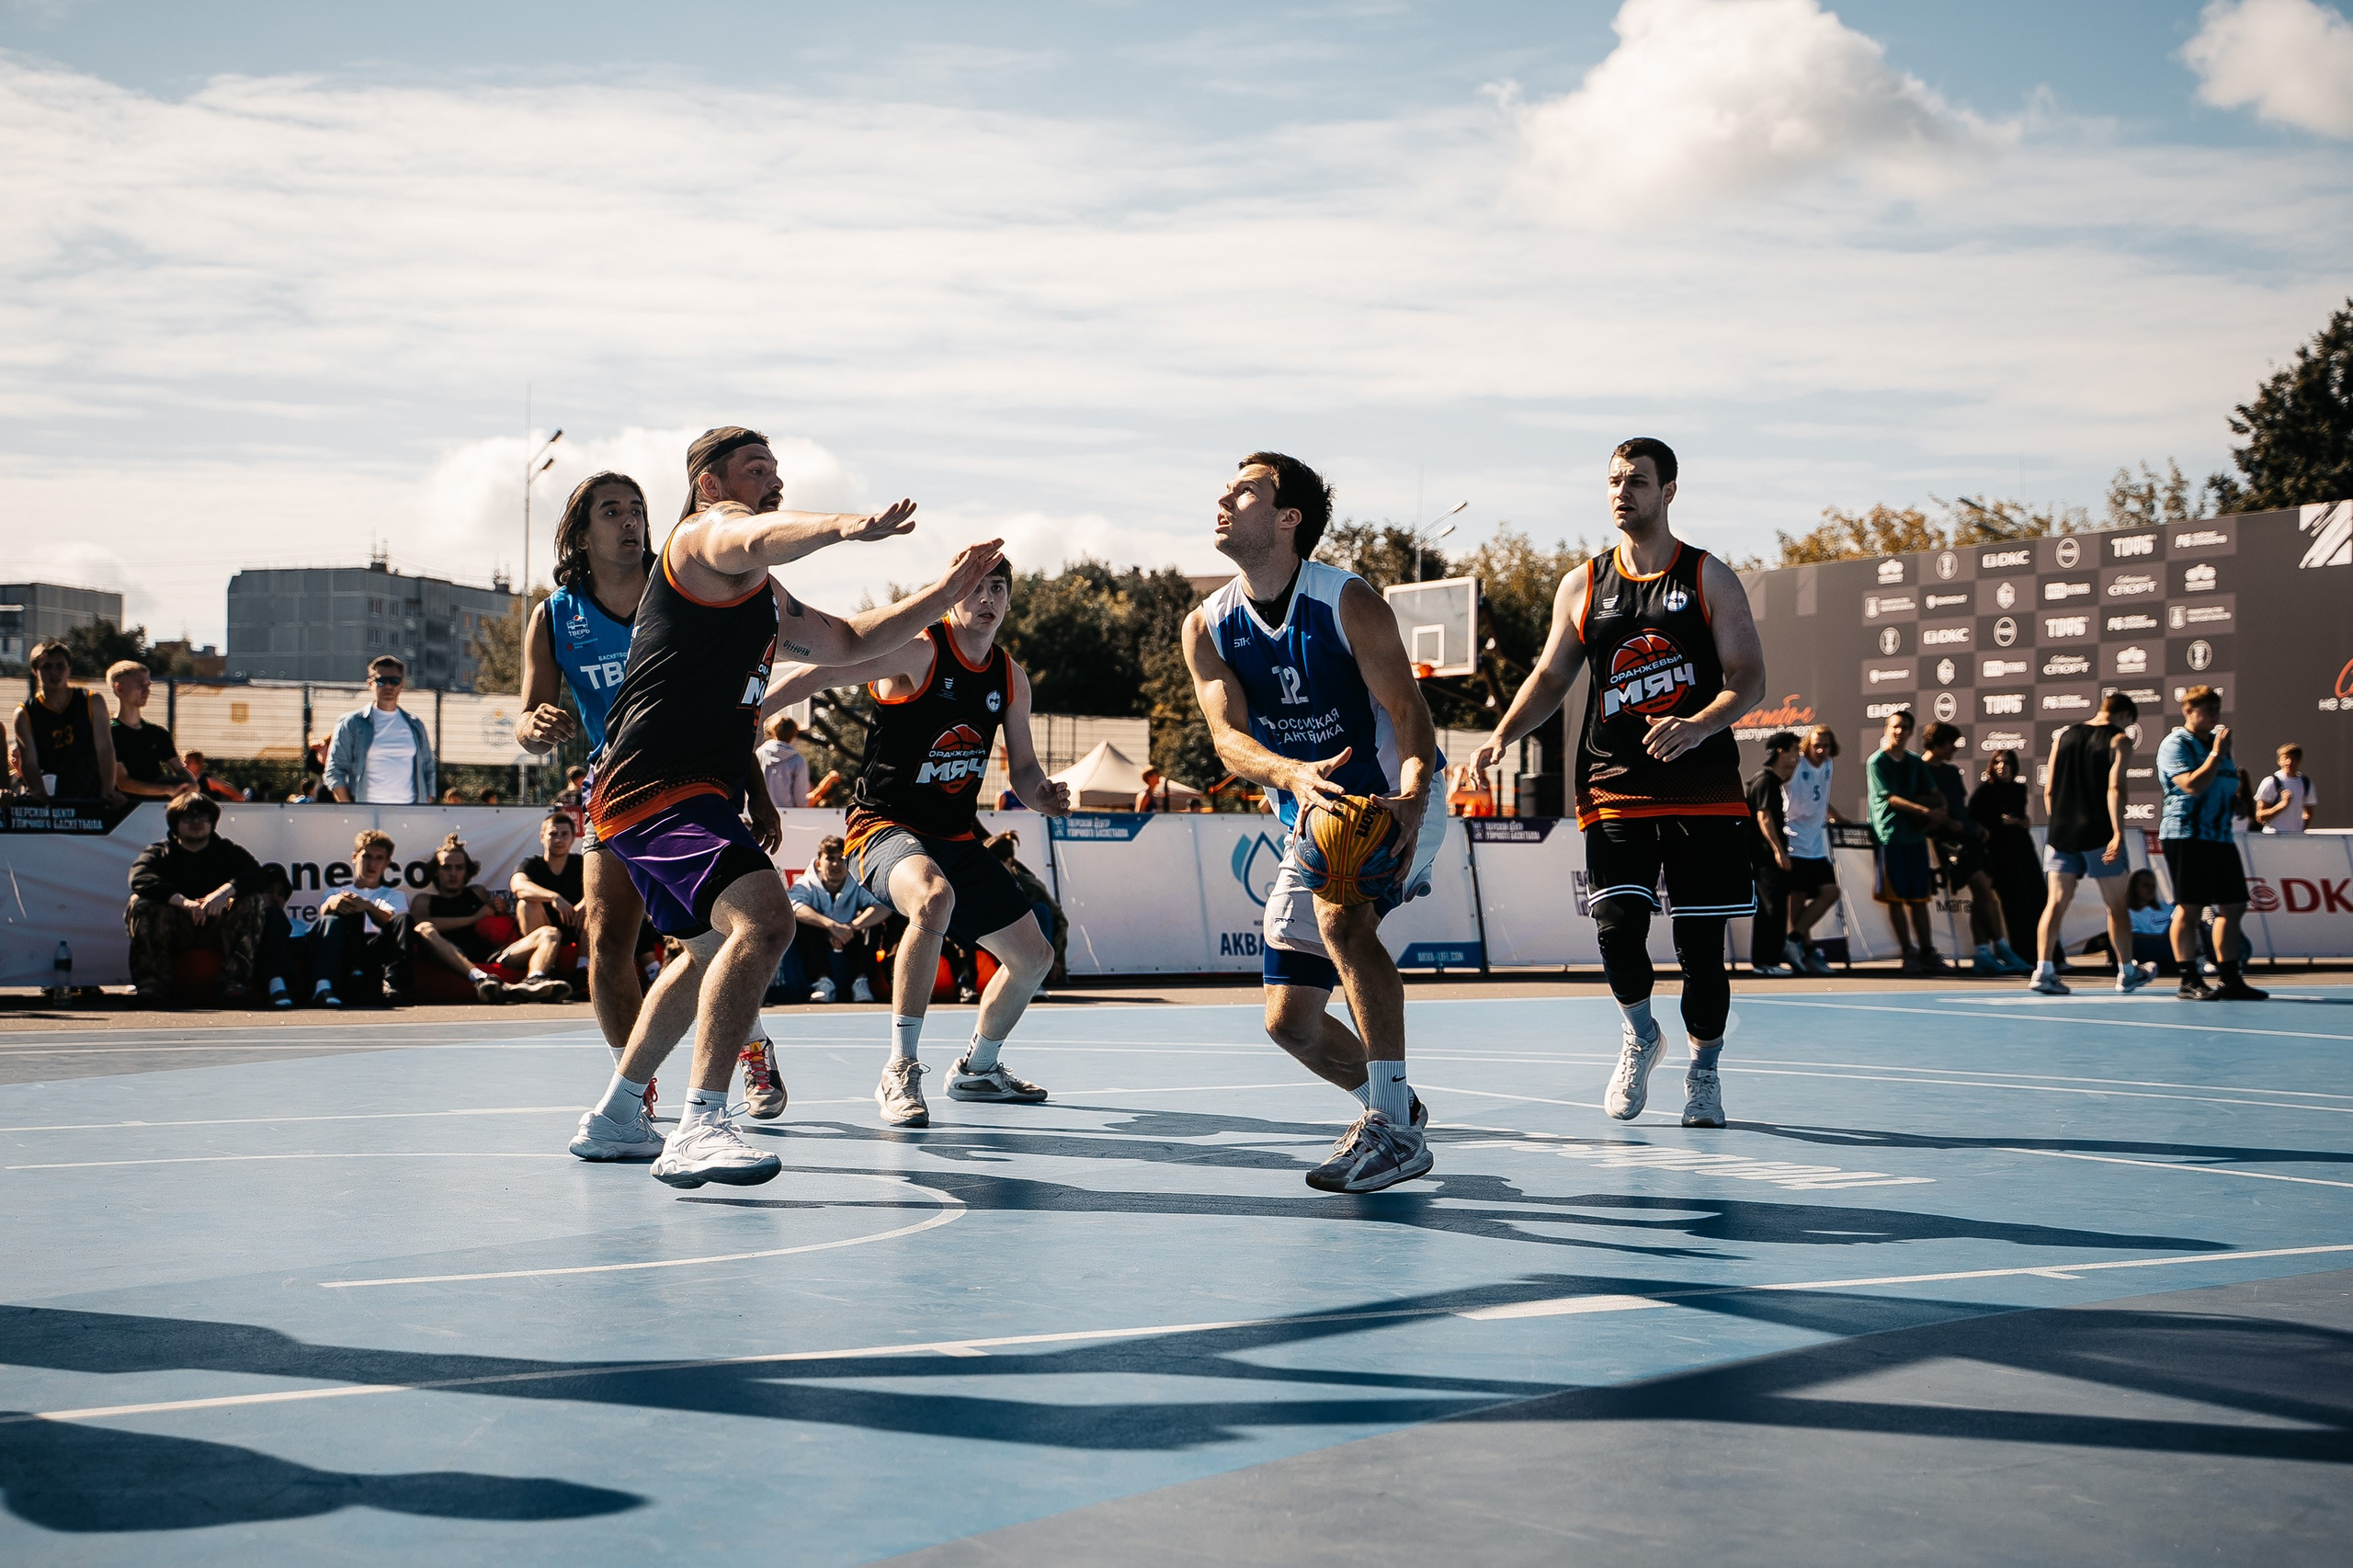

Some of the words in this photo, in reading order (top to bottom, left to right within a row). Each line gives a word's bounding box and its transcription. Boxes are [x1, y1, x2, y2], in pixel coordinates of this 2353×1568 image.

[598, 652, 628, 661] БАСКЕТБО
[1233, 637, 1251, 648] STK
[580, 661, 628, 689] ТВ
[1609, 653, 1683, 684] ОРАНЖЕВЫЙ
[1271, 665, 1309, 705] 12
[1604, 663, 1696, 717] МЯЧ
[915, 757, 989, 783] МЯЧ
[2279, 878, 2353, 914] DK
